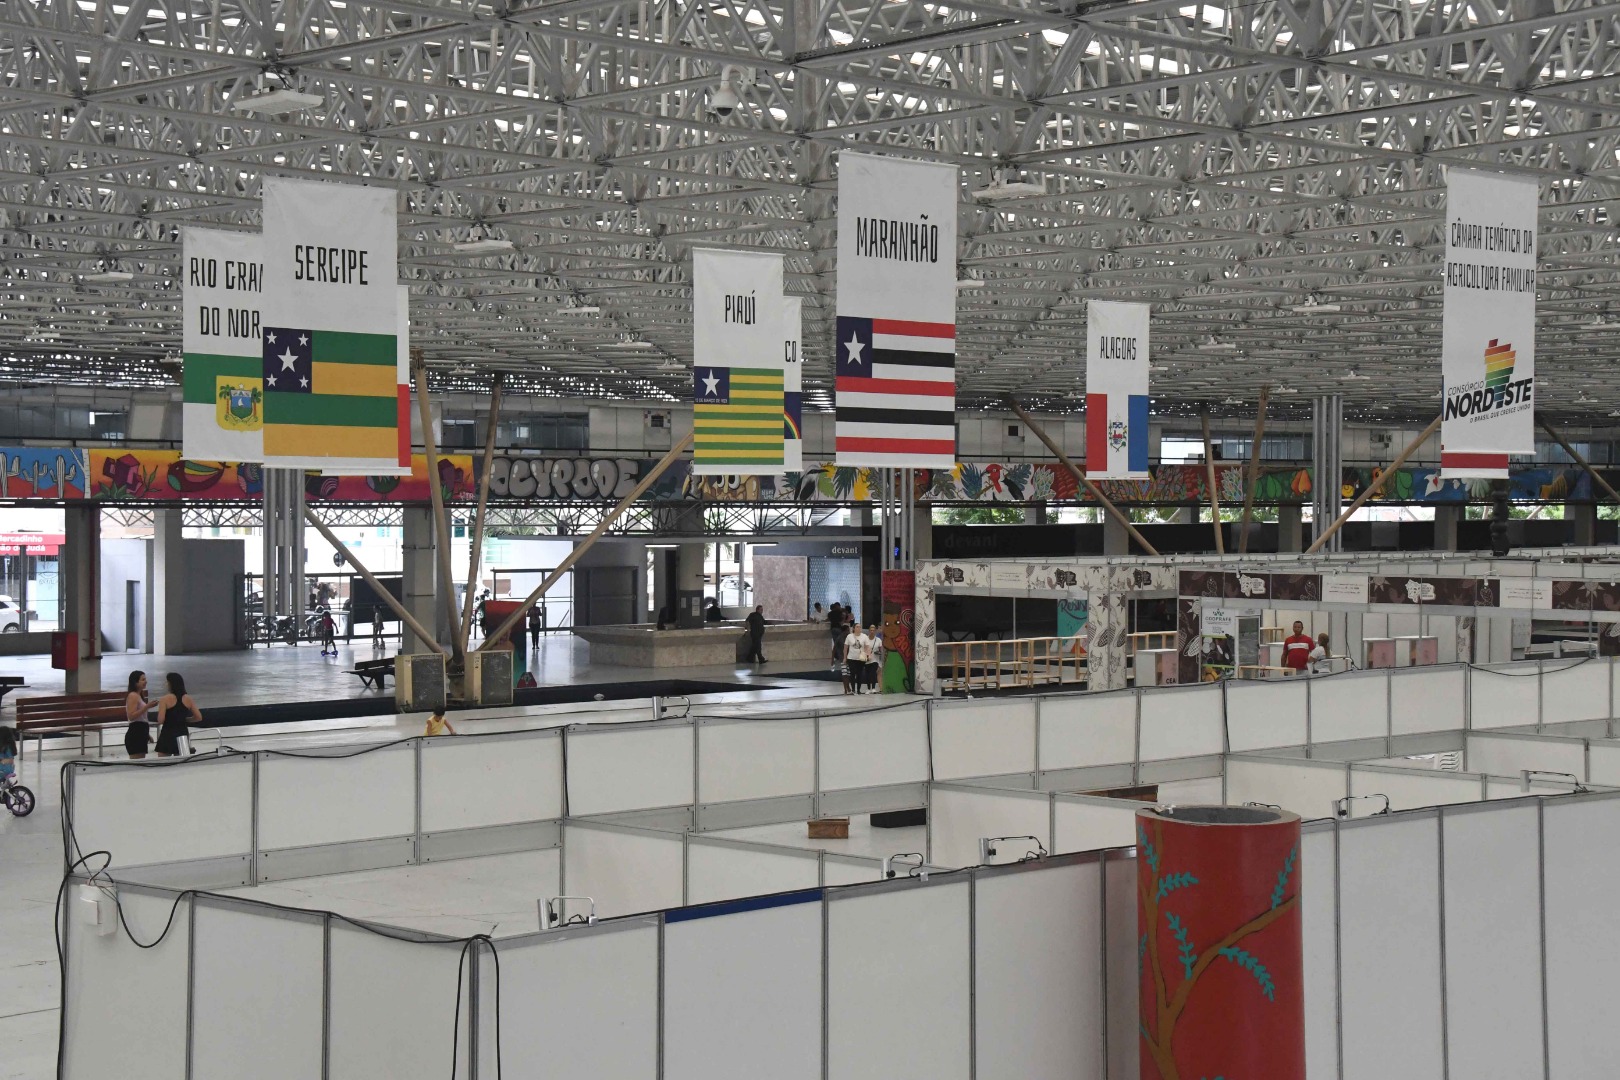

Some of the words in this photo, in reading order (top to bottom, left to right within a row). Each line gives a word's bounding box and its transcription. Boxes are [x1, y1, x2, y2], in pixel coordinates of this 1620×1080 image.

[856, 213, 938, 263] MARANHÃO
[1451, 217, 1482, 250] CÂMARA
[1485, 222, 1521, 254] TEMÁTICA
[1523, 230, 1533, 255] DA
[190, 257, 216, 288] RIO
[295, 244, 368, 286] SERGIPE
[1446, 262, 1499, 291] AGRICULTURA
[1501, 267, 1535, 294] FAMILIAR
[200, 306, 220, 336] DO
[228, 308, 262, 339] NOR
[725, 289, 756, 325] PIAUÍ
[1100, 336, 1137, 360] ALAGOAS
[1448, 380, 1485, 396] CONSÓRCIO
[0, 534, 43, 543] ercadinho
[831, 546, 858, 554] devant
